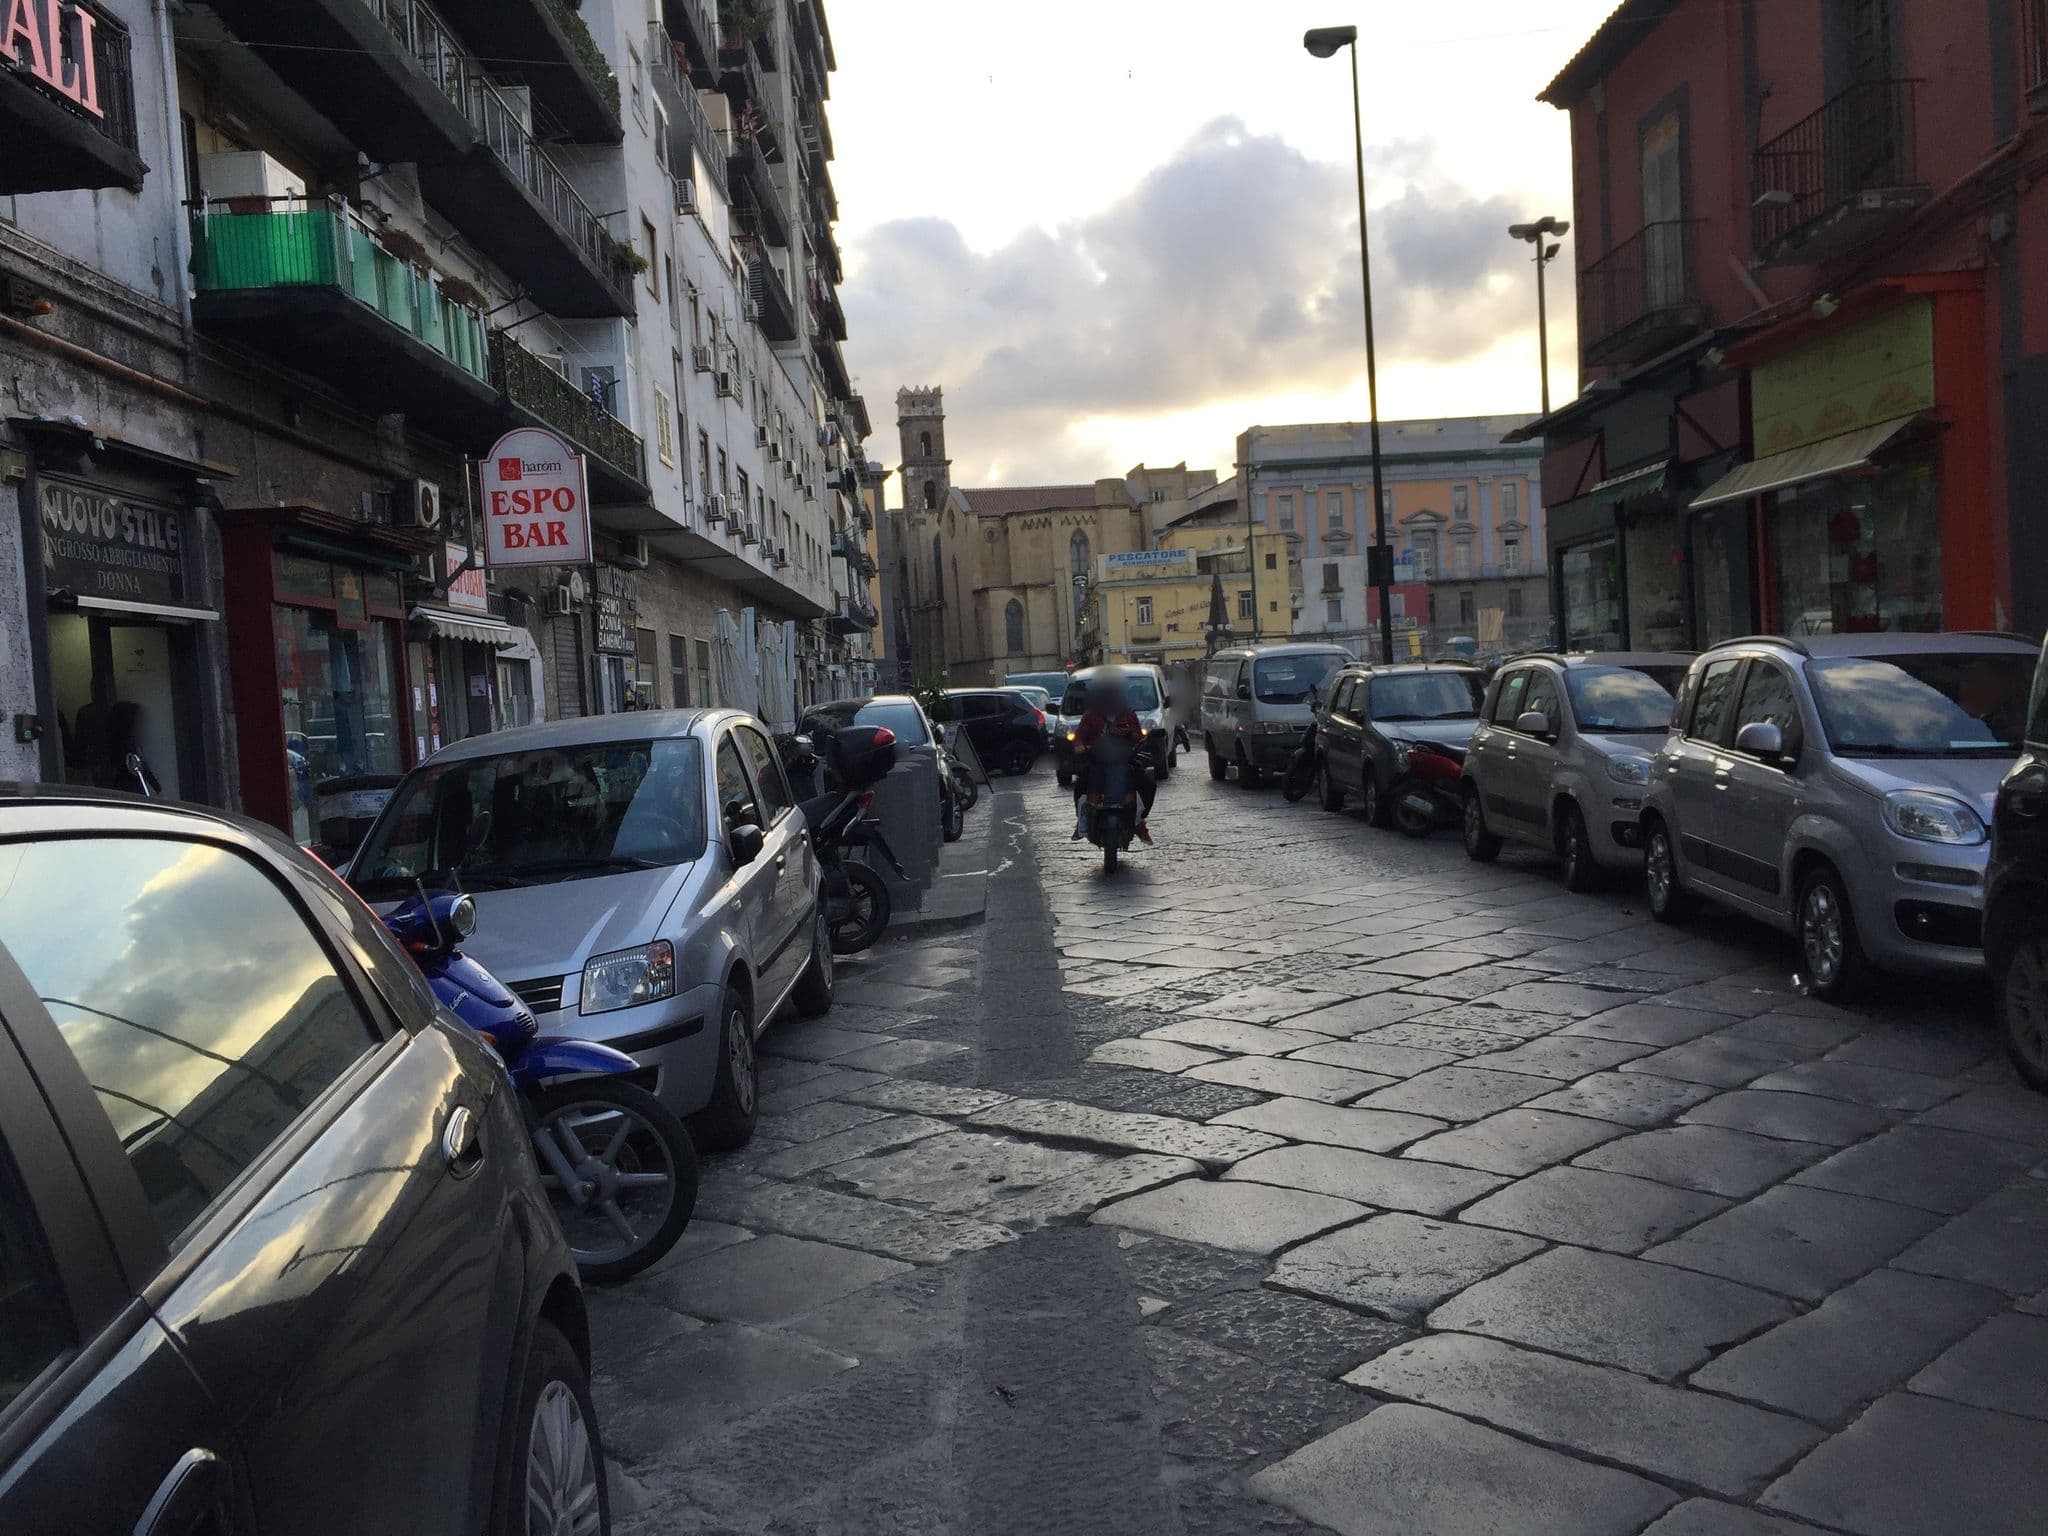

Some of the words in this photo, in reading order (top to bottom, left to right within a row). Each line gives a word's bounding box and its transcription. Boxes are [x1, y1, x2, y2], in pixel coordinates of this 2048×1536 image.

[490, 487, 576, 516] ESPO
[41, 491, 116, 540] NUOVO
[120, 506, 178, 551] STILE
[503, 521, 569, 549] BAR
[43, 535, 100, 562] INGROSSO
[102, 547, 181, 575] ABBIGLIAMENTO
[1109, 550, 1186, 561] PESCATORE
[97, 571, 142, 594] DONNA
[599, 615, 621, 632] DONNA
